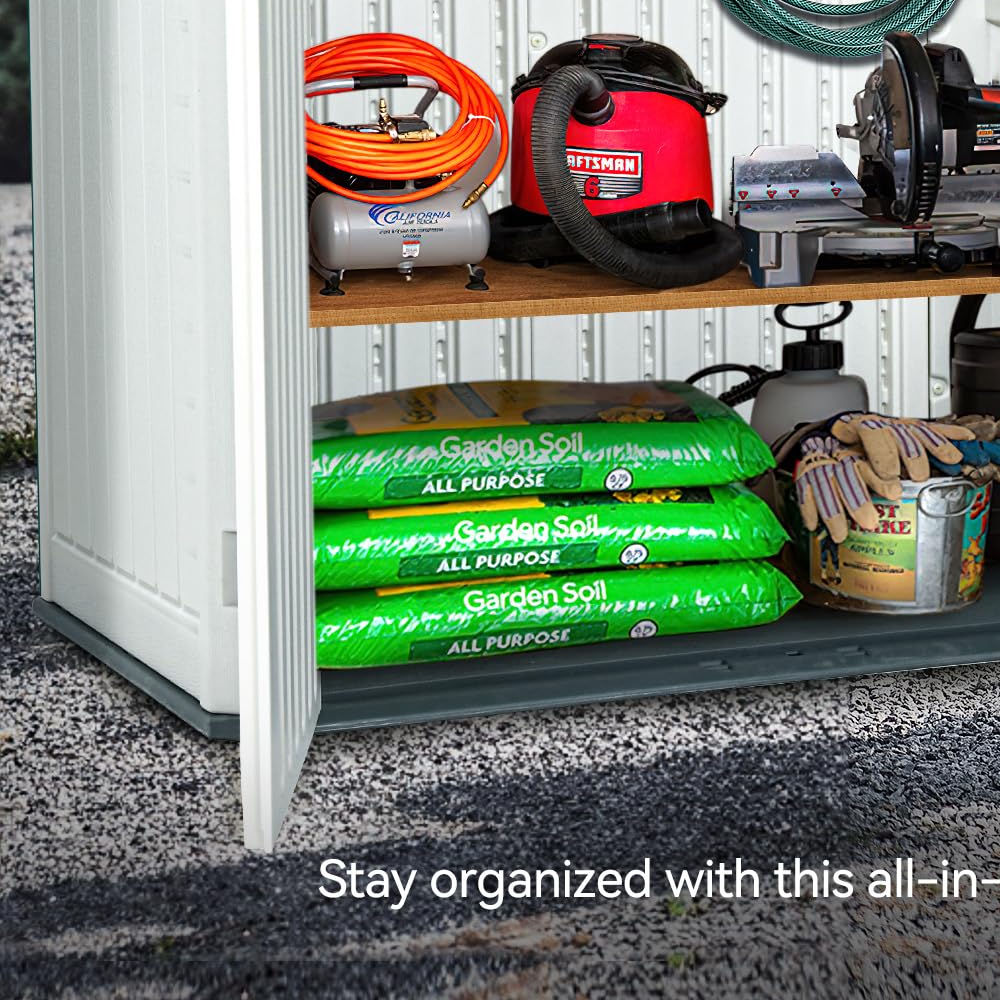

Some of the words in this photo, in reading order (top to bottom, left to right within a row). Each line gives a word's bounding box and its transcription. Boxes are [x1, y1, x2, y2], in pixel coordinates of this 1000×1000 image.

[566, 154, 635, 173] AFTSMAN
[584, 176, 600, 199] 6
[383, 210, 452, 225] CALIFORNIA
[439, 433, 535, 459] Garden
[538, 431, 584, 454] Soil
[422, 477, 458, 495] ALL
[461, 472, 545, 492] PURPOSE
[453, 517, 549, 545] Garden
[552, 514, 599, 539] Soil
[436, 557, 471, 574] ALL
[475, 549, 561, 569] PURPOSE
[463, 586, 557, 612] Garden
[563, 580, 607, 603] Soil
[447, 639, 482, 656] ALL
[486, 628, 571, 651] PURPOSE
